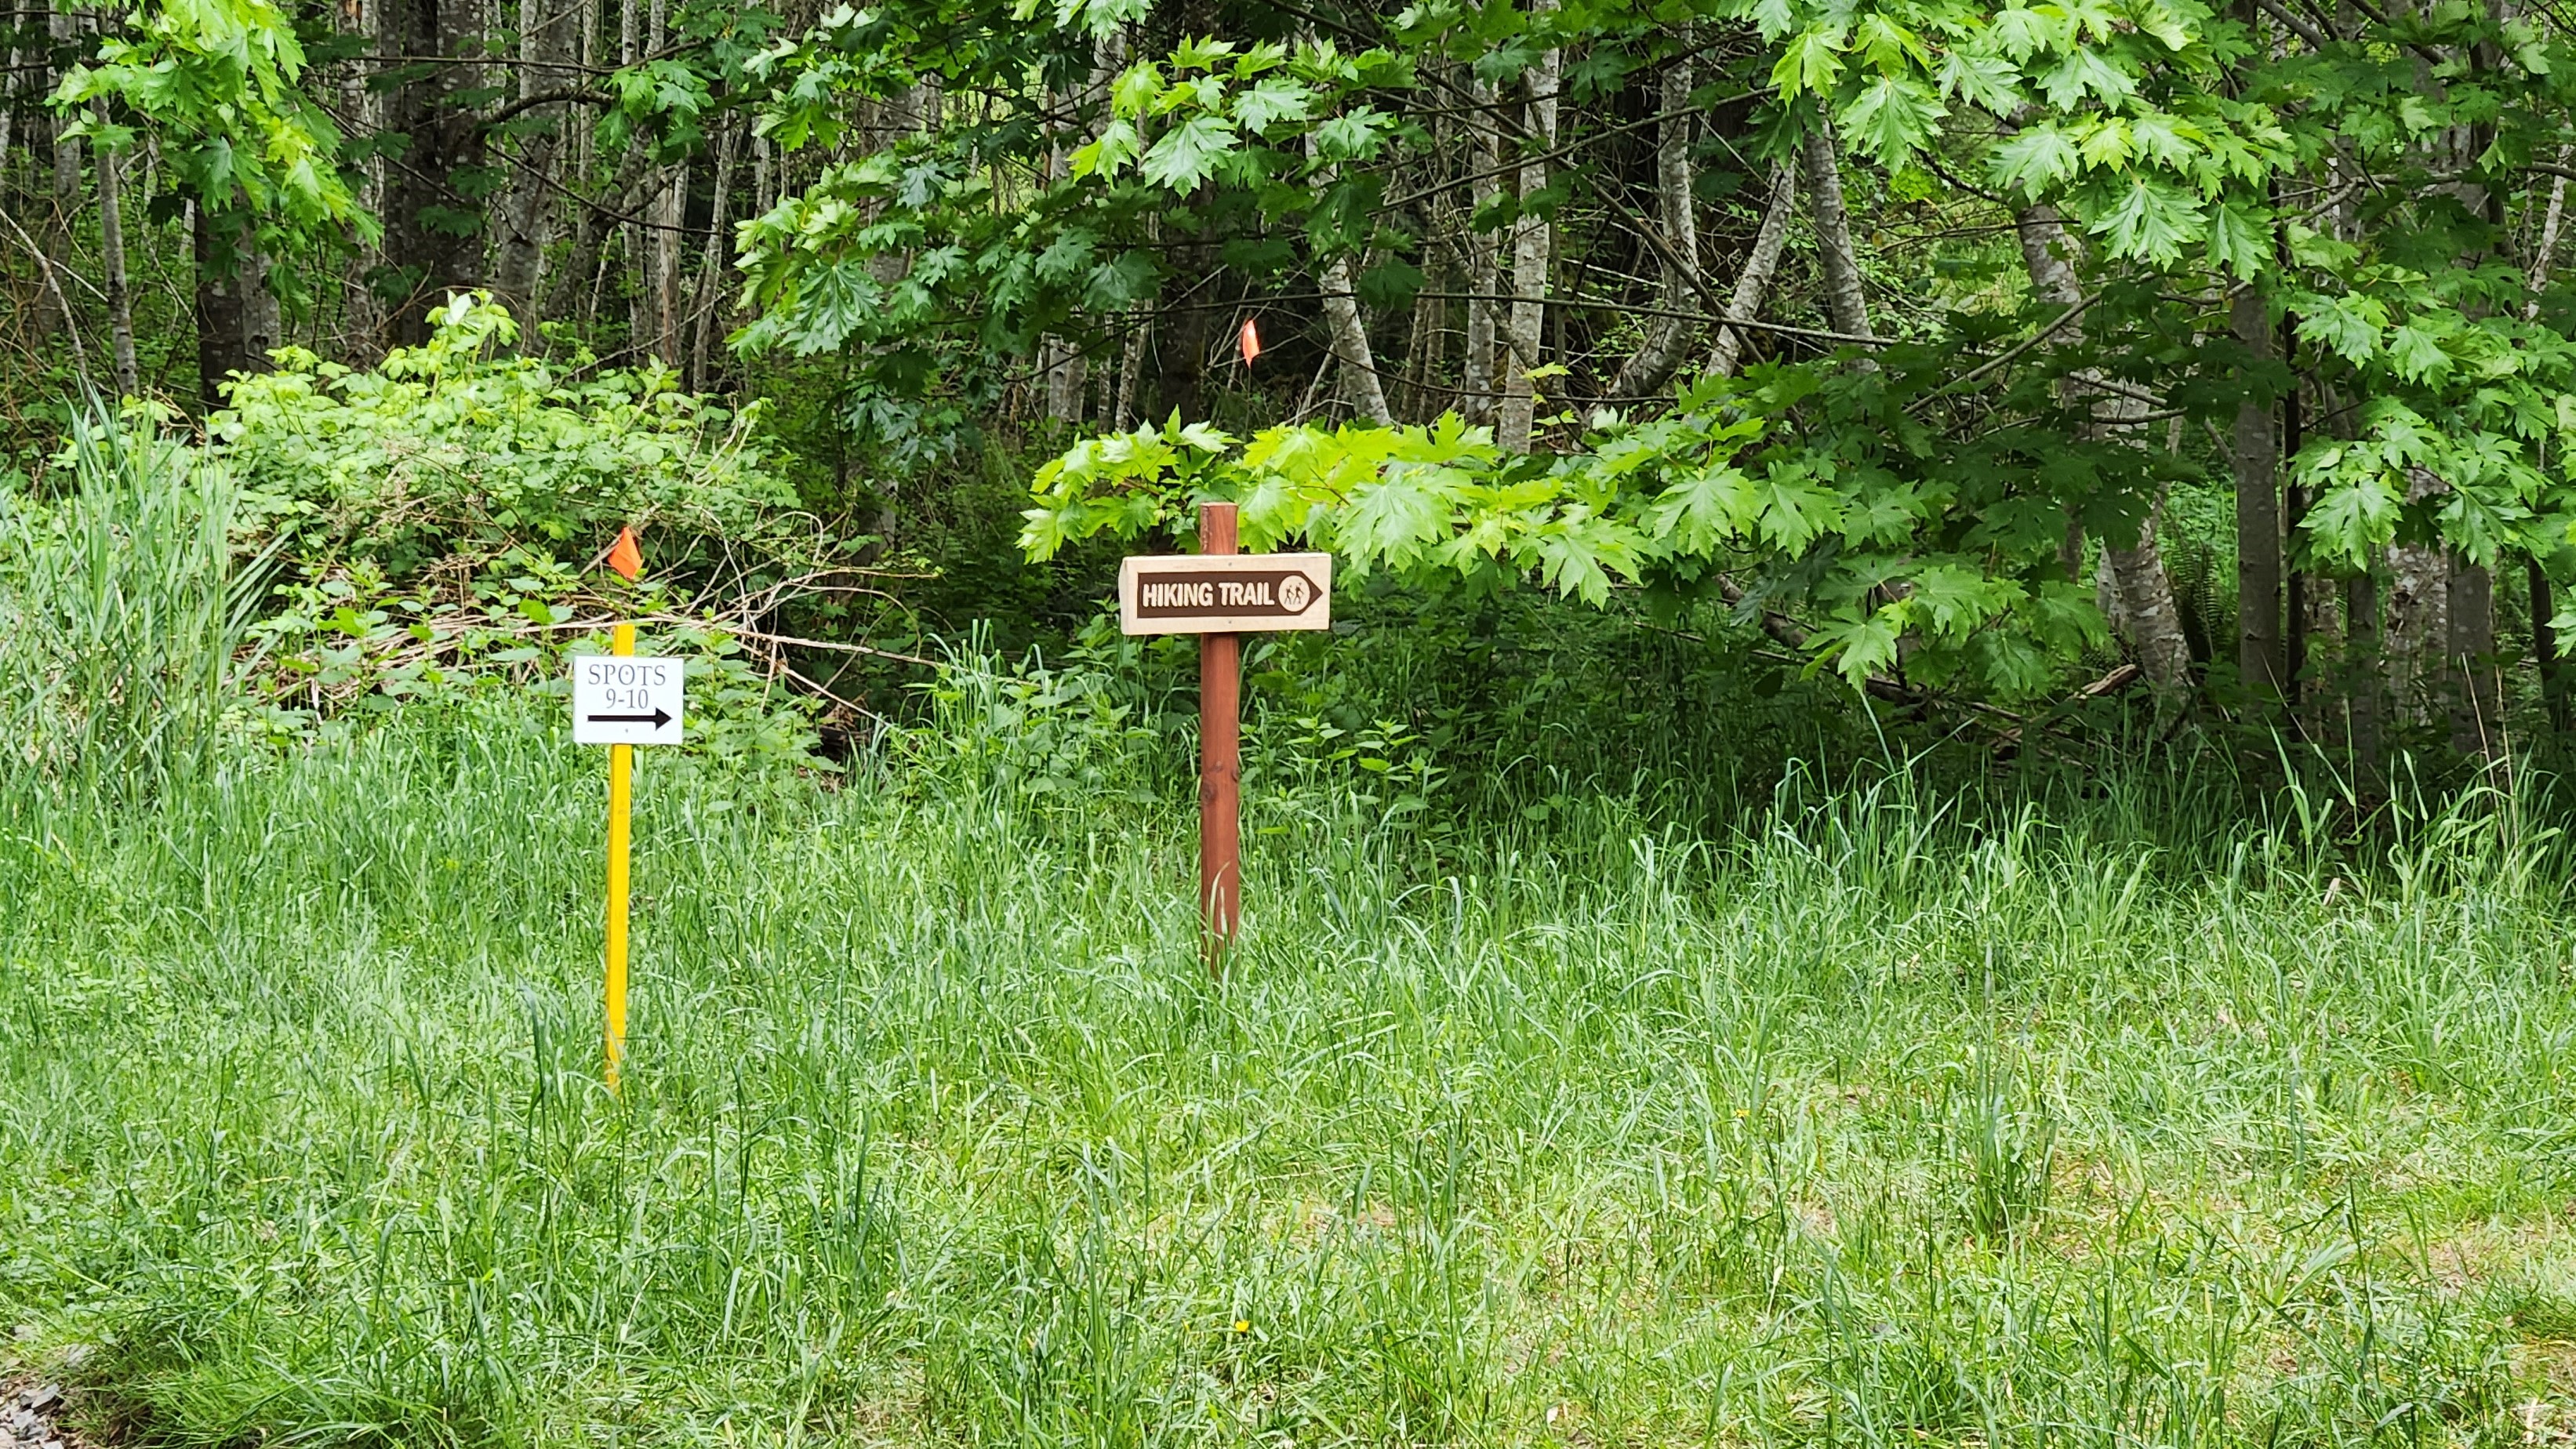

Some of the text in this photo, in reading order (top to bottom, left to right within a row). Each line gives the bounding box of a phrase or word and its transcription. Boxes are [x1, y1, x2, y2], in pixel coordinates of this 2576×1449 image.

[1143, 582, 1275, 607] HIKING TRAIL
[588, 664, 666, 686] SPOTS
[606, 688, 649, 709] 9-10
